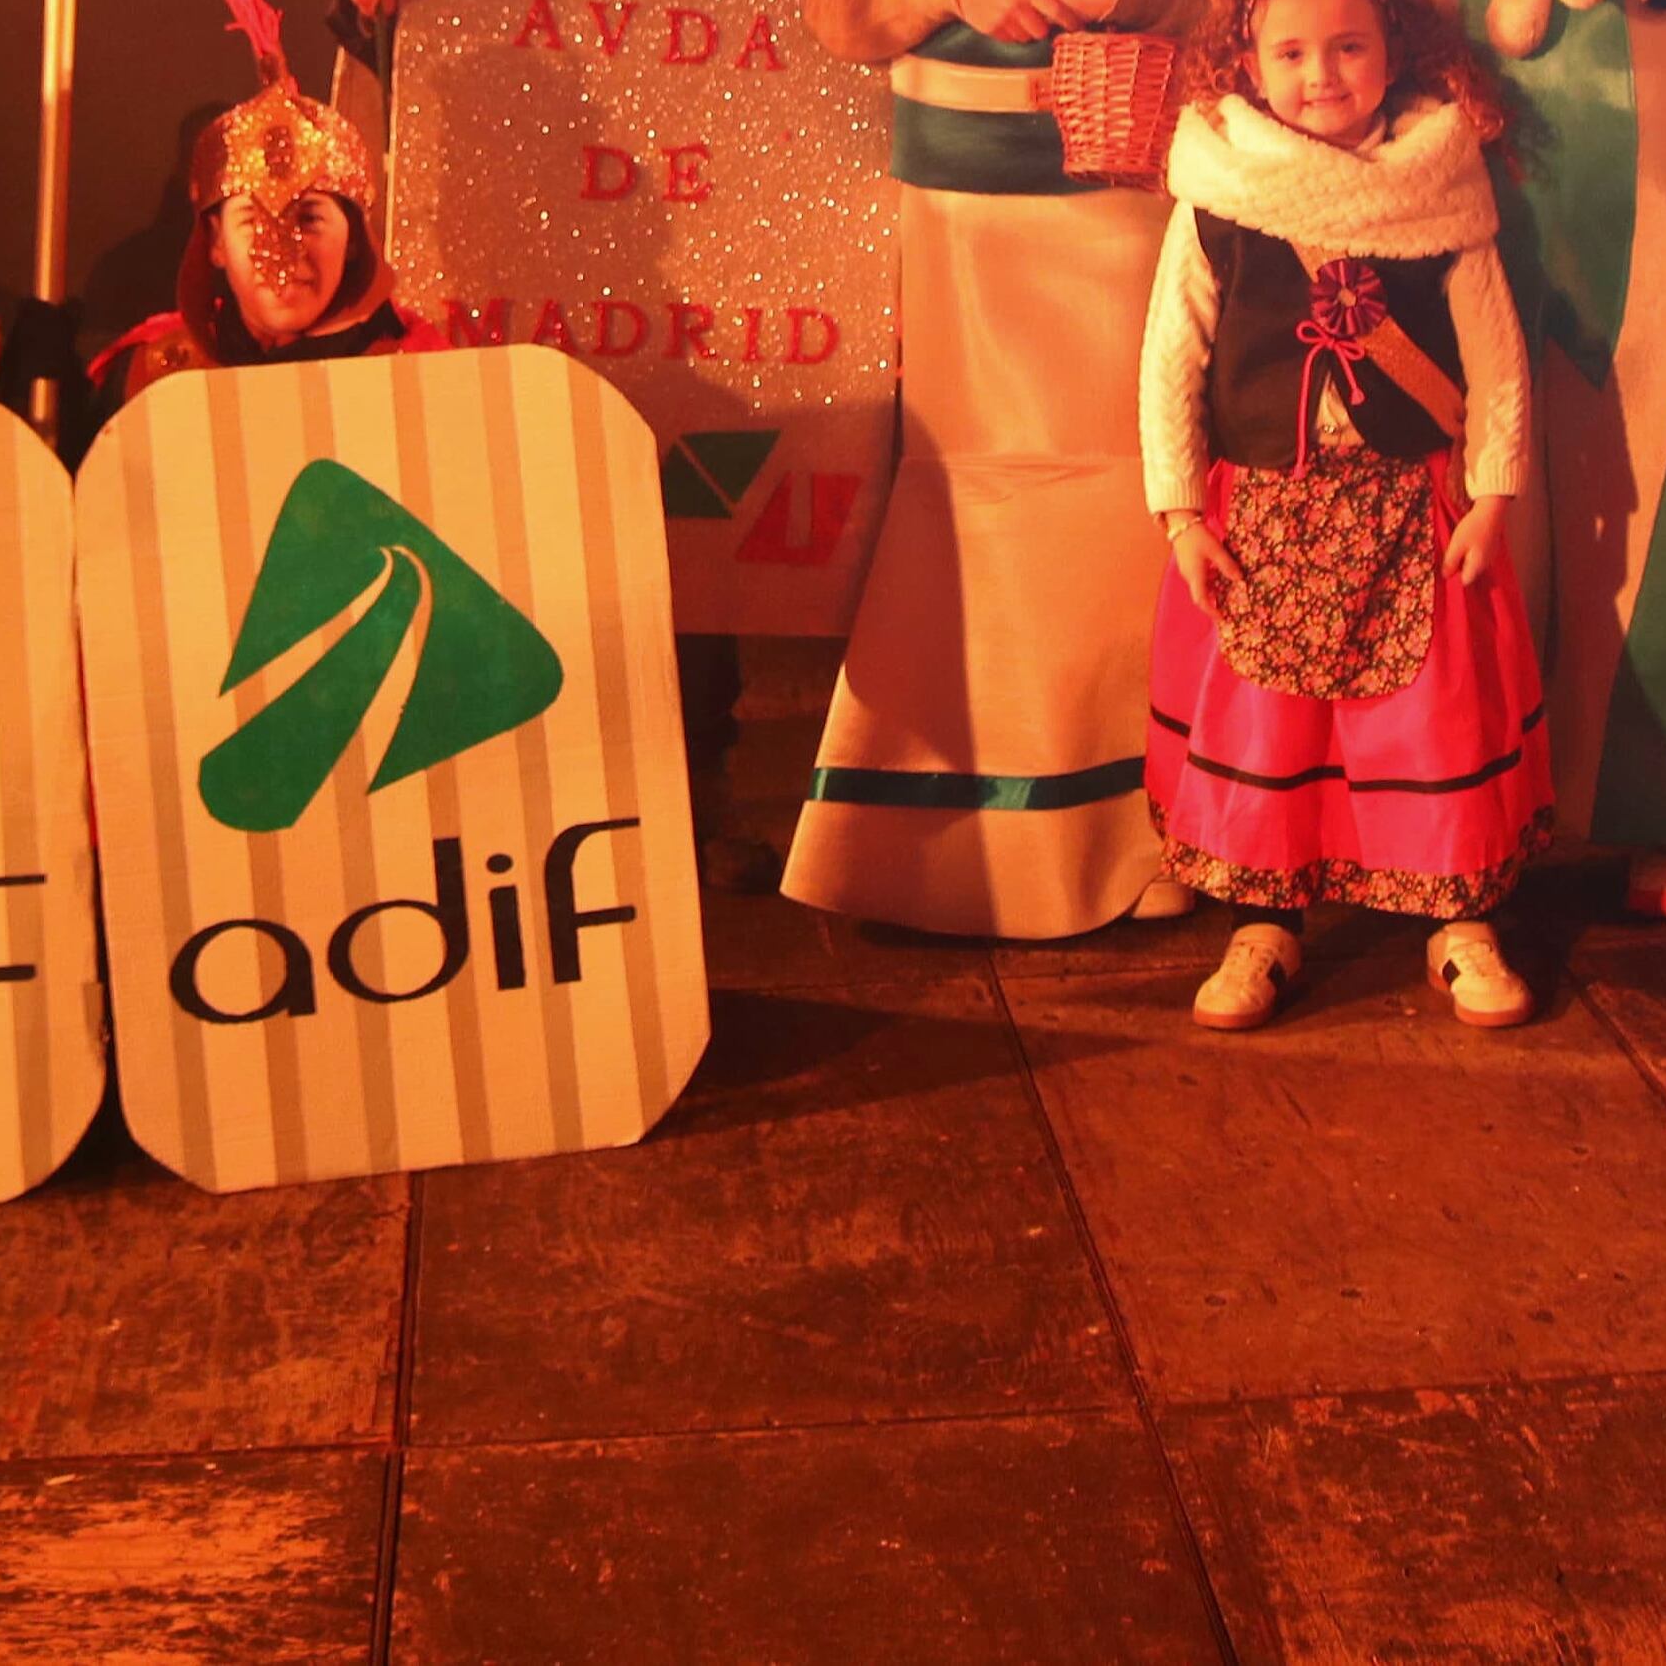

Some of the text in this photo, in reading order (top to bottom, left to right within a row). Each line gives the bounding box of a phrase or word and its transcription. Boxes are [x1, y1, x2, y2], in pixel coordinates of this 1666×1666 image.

[579, 144, 715, 204] DE
[441, 297, 841, 366] MADRID
[168, 817, 641, 1024] adif
